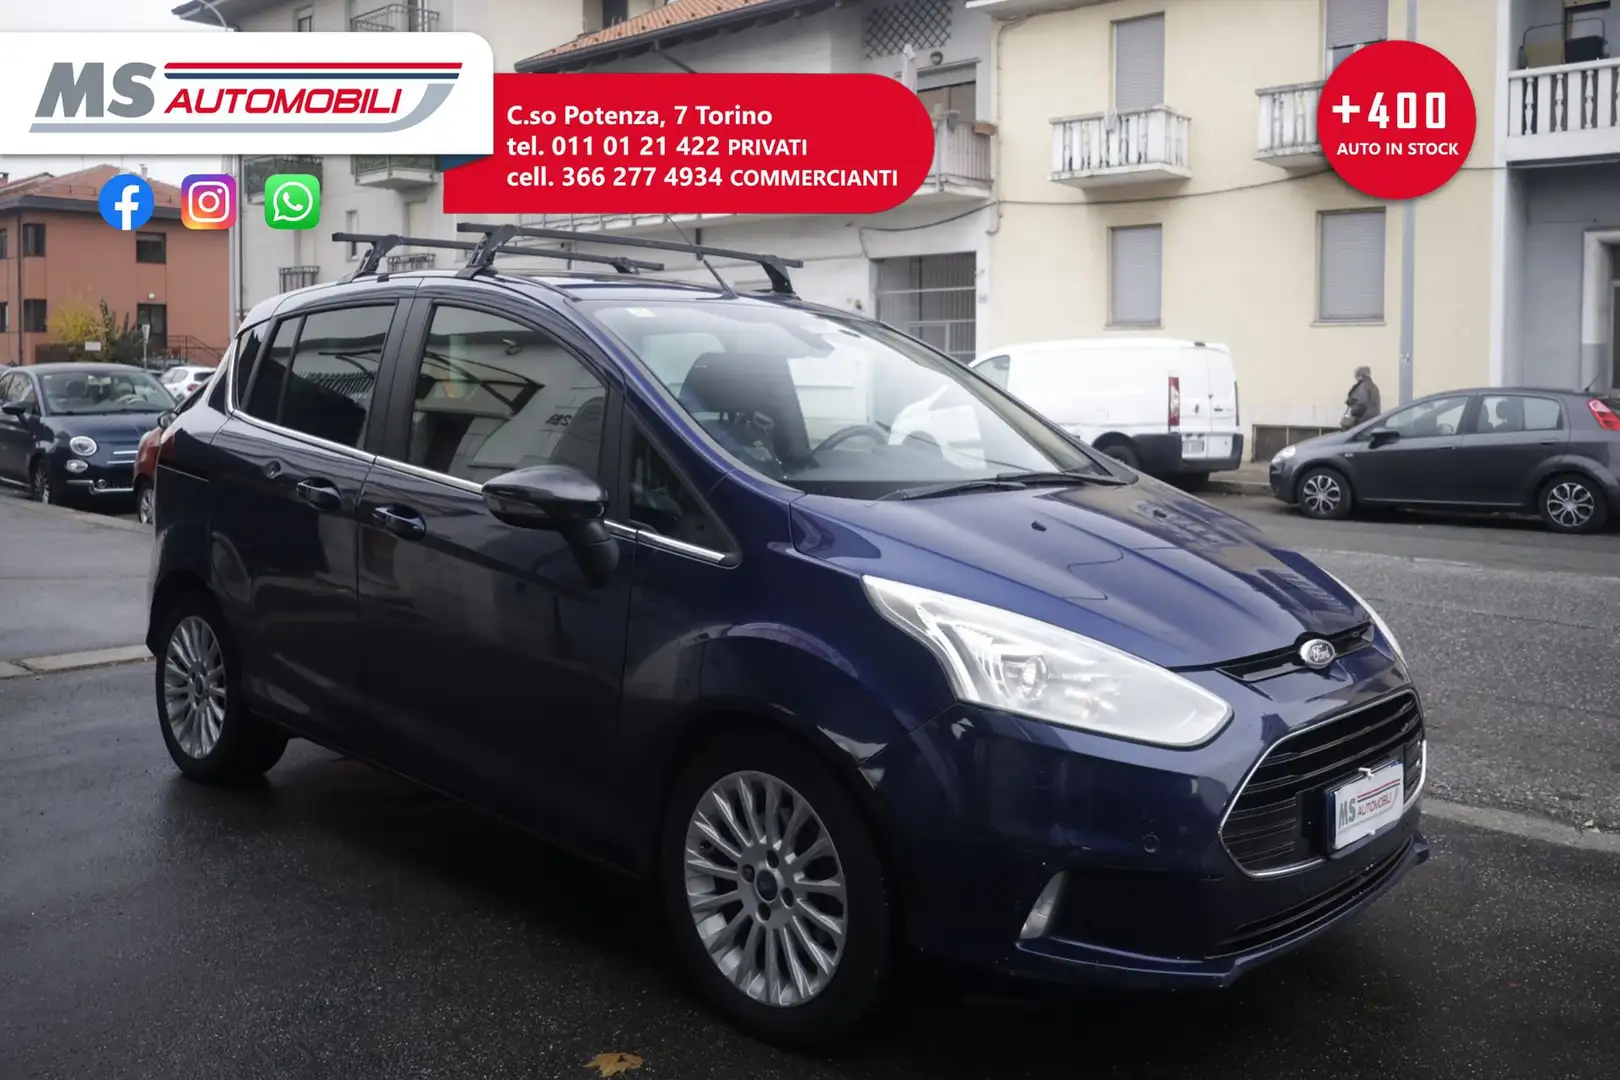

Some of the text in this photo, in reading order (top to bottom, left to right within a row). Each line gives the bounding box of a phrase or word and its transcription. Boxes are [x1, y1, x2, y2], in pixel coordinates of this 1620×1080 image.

[1310, 643, 1331, 662] Ford
[1338, 792, 1392, 829] MS AUTOMOBILI
